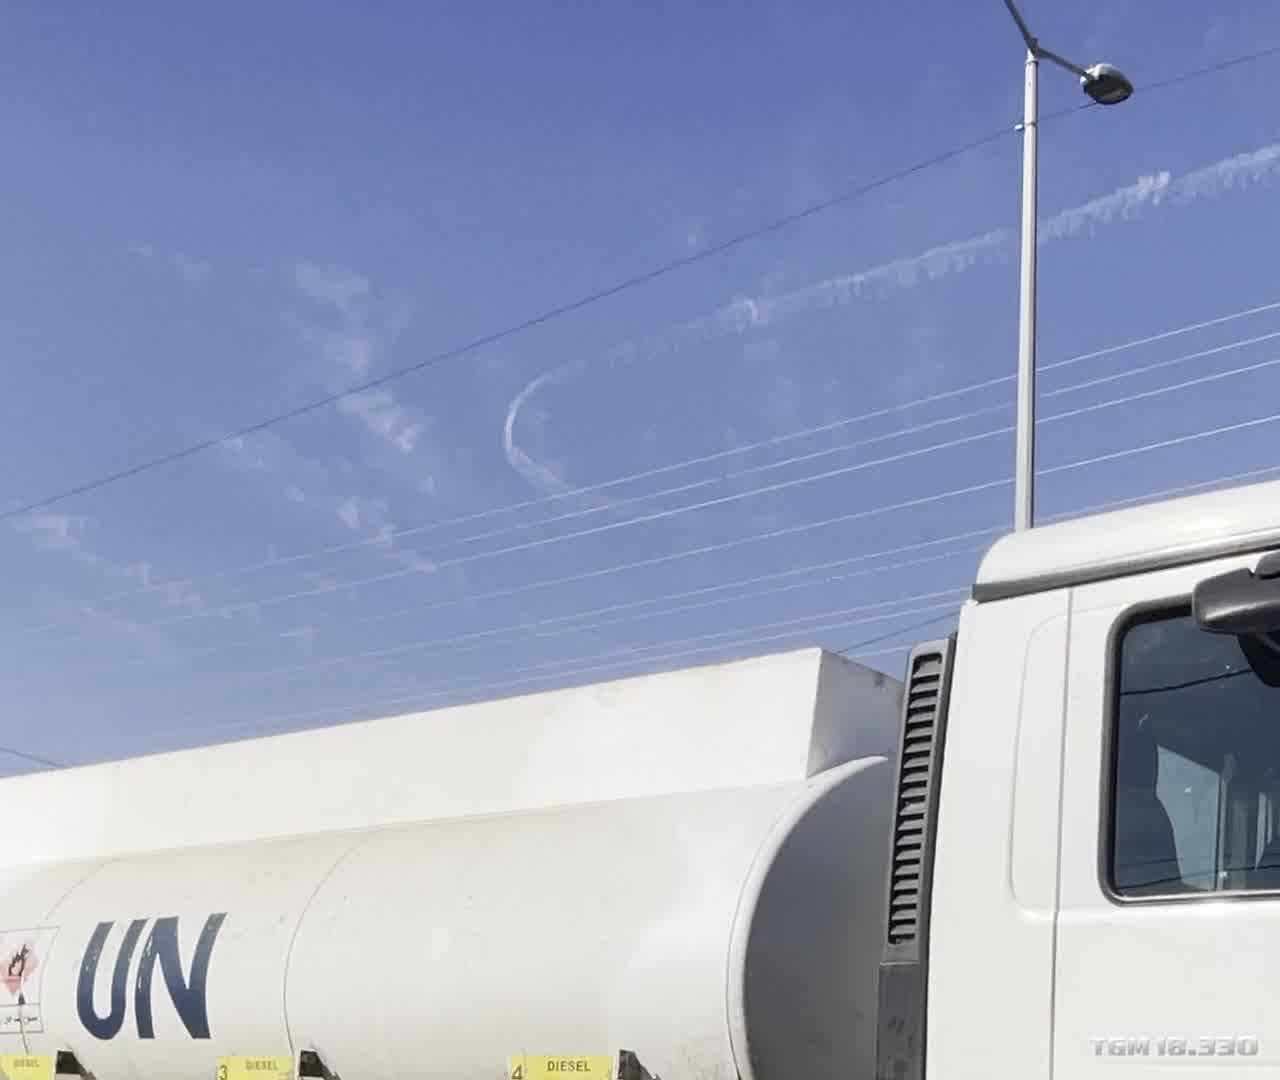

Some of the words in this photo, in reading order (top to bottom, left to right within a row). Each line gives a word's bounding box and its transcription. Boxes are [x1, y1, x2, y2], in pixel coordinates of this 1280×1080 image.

[77, 912, 227, 1040] UN
[1156, 1036, 1260, 1056] 18.330
[219, 1064, 228, 1080] 3
[245, 1059, 280, 1071] DIESEL
[547, 1060, 591, 1072] DIESEL
